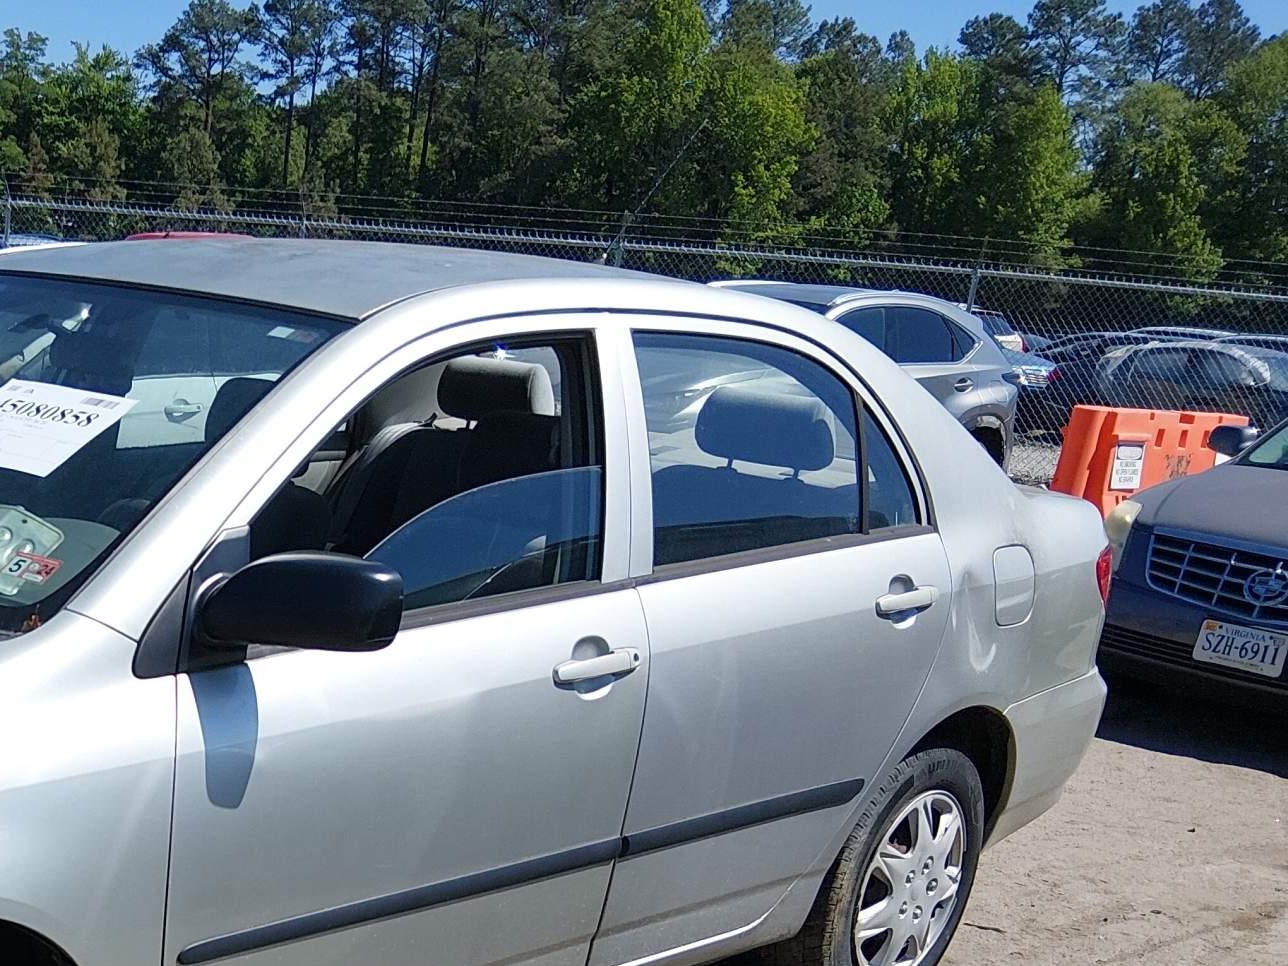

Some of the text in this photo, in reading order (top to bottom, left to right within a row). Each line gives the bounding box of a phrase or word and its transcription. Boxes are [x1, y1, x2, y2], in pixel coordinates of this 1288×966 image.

[8, 559, 27, 573] 5
[1224, 626, 1266, 643] VIRGINIA
[1201, 632, 1280, 666] SZH-6911
